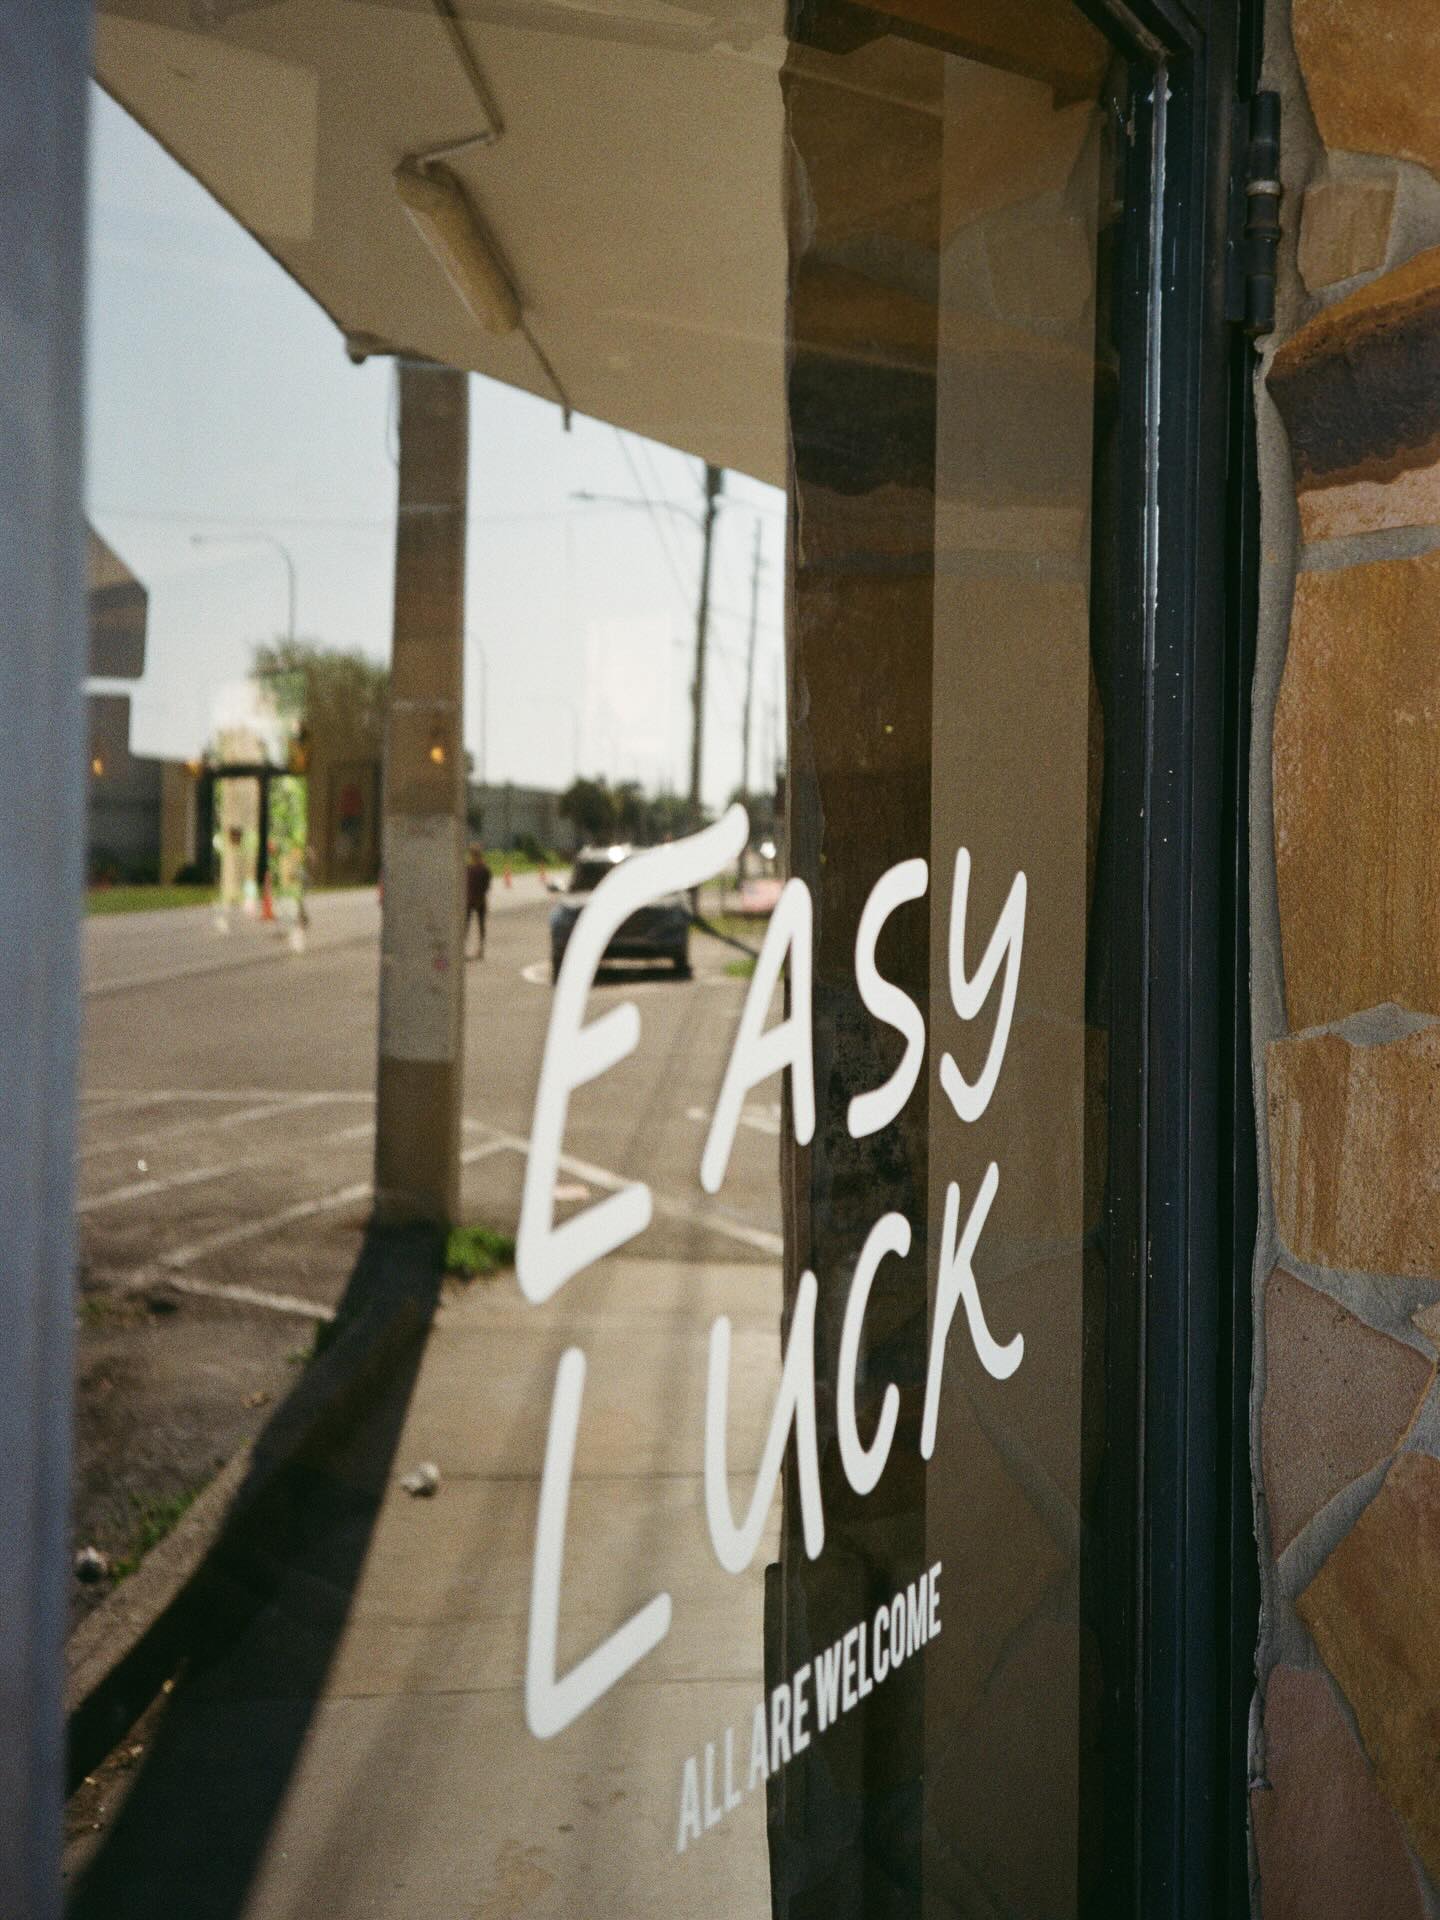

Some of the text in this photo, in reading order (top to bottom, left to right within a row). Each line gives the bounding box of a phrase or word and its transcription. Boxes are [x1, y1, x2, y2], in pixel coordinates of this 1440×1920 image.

[523, 1160, 1025, 1740] LUCK
[676, 1561, 943, 1854] ALL ARE WELCOME
